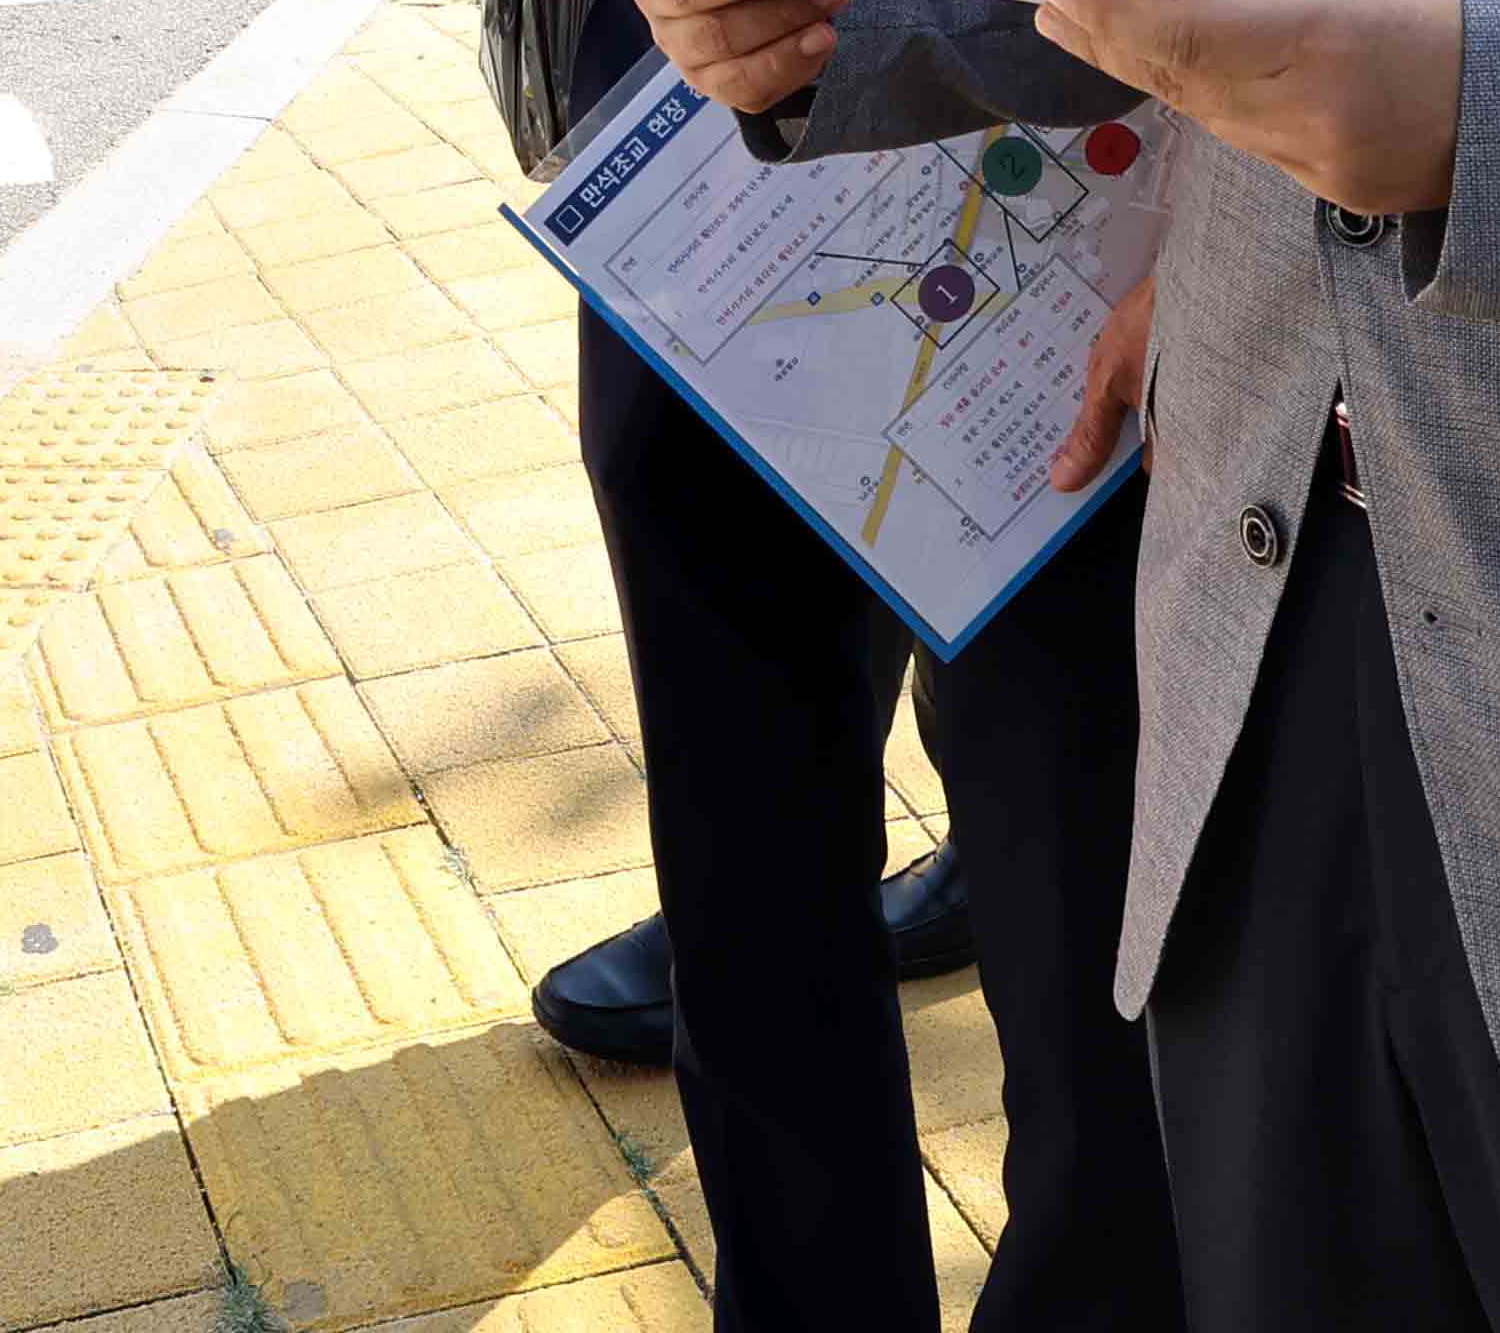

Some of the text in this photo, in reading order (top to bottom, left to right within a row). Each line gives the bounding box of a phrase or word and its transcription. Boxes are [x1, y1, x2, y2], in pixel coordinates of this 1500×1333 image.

[580, 97, 687, 207] 만석초교 현장
[935, 284, 959, 305] 1
